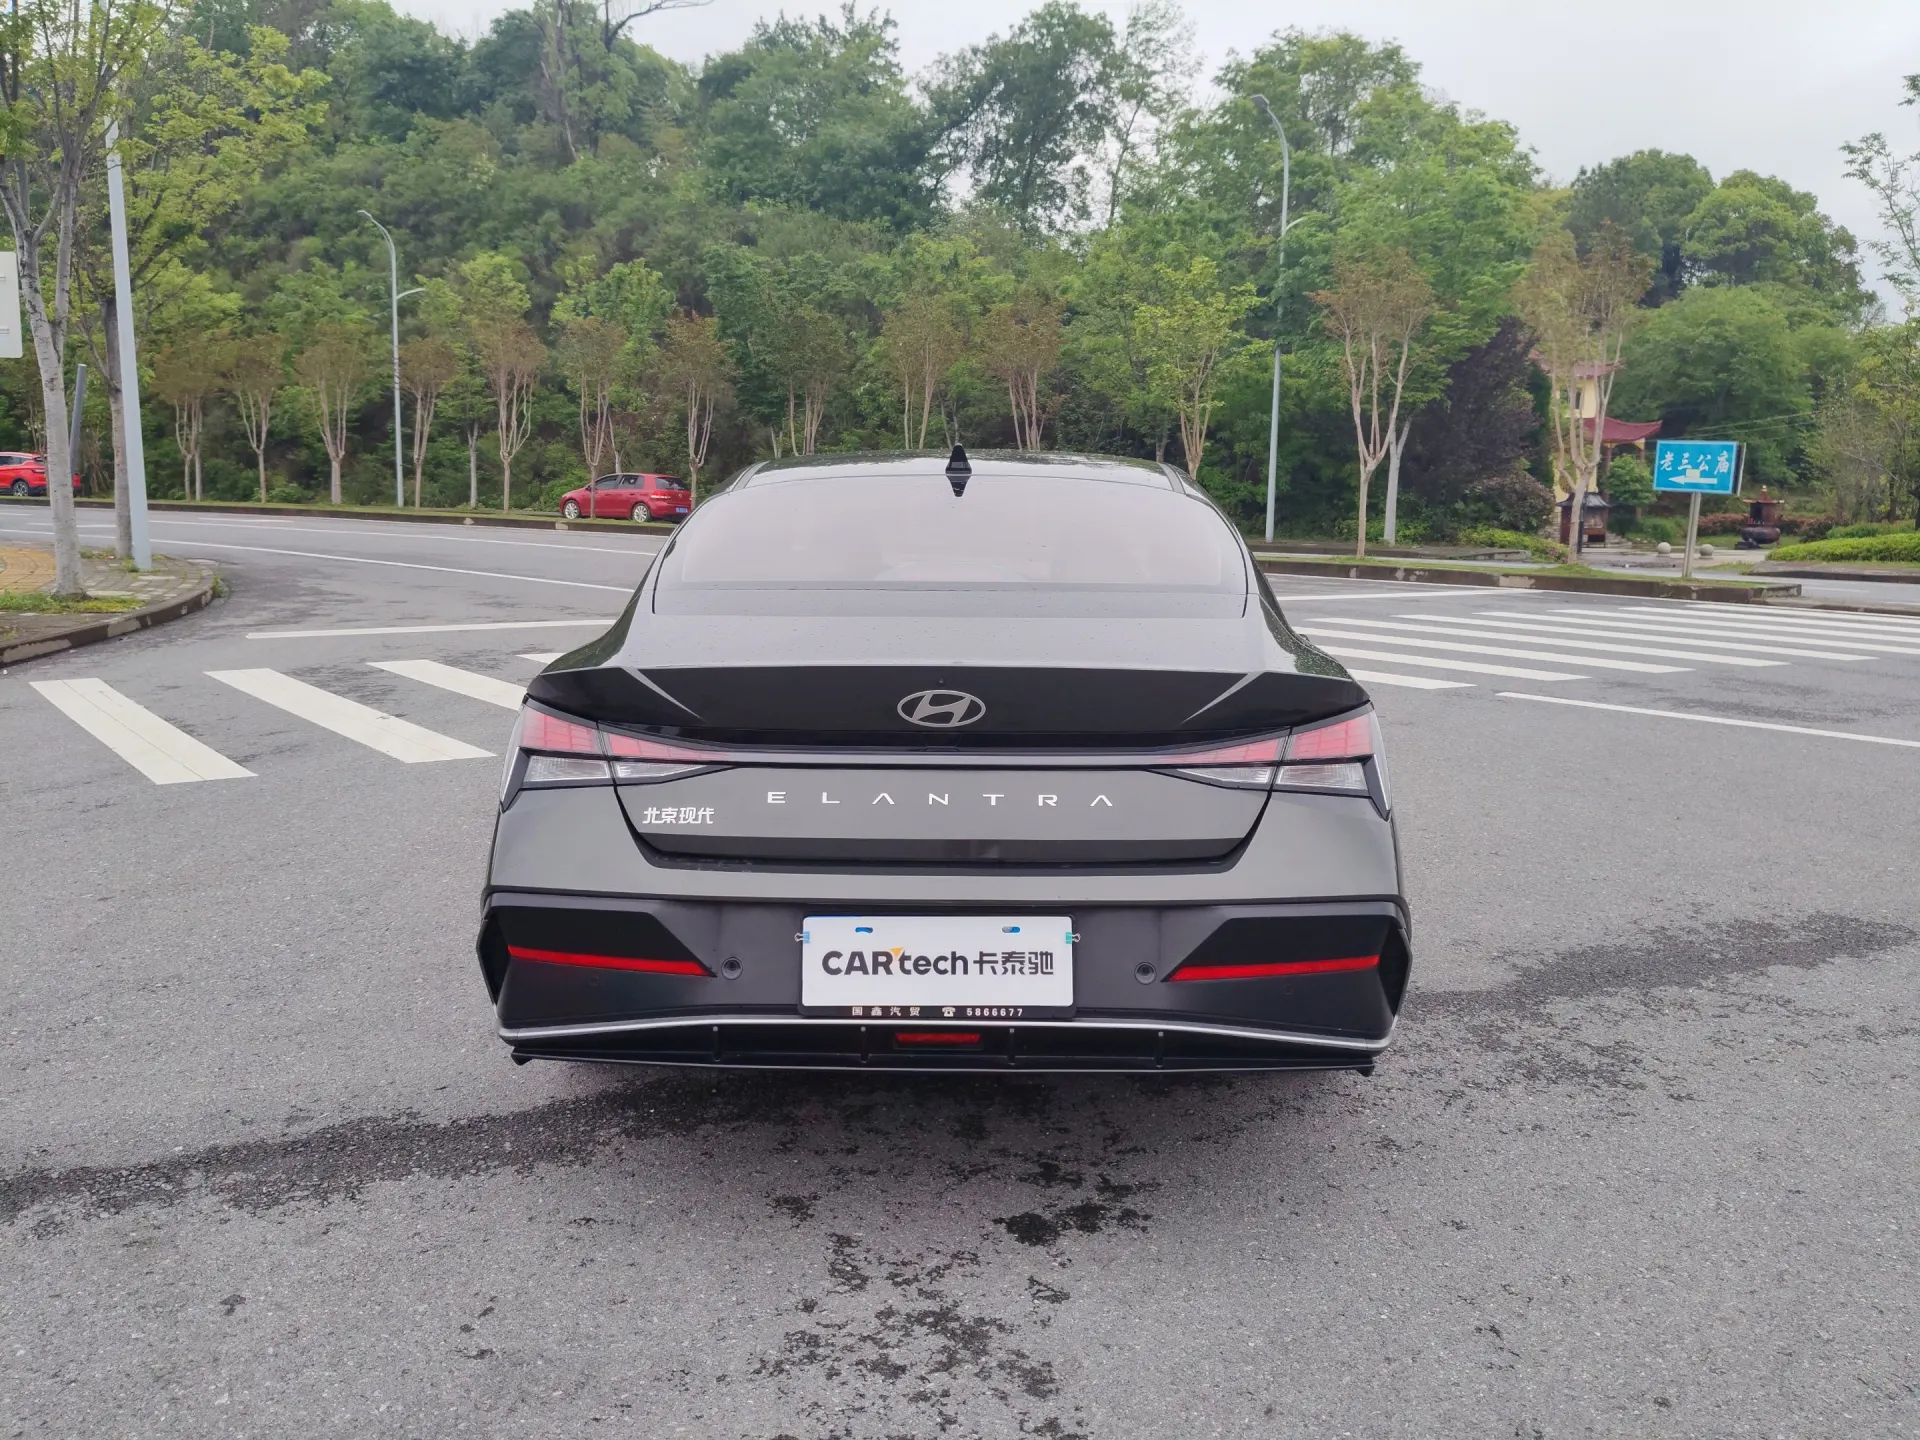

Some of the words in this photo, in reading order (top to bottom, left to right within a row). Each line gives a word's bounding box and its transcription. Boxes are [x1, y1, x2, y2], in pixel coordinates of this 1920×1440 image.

[766, 790, 1114, 807] ELANTRA
[642, 807, 715, 824] 北京现代
[973, 950, 1054, 976] 卡泰驰
[852, 1006, 921, 1017] 国鑫汽贸
[966, 1007, 1023, 1017] 5866677
